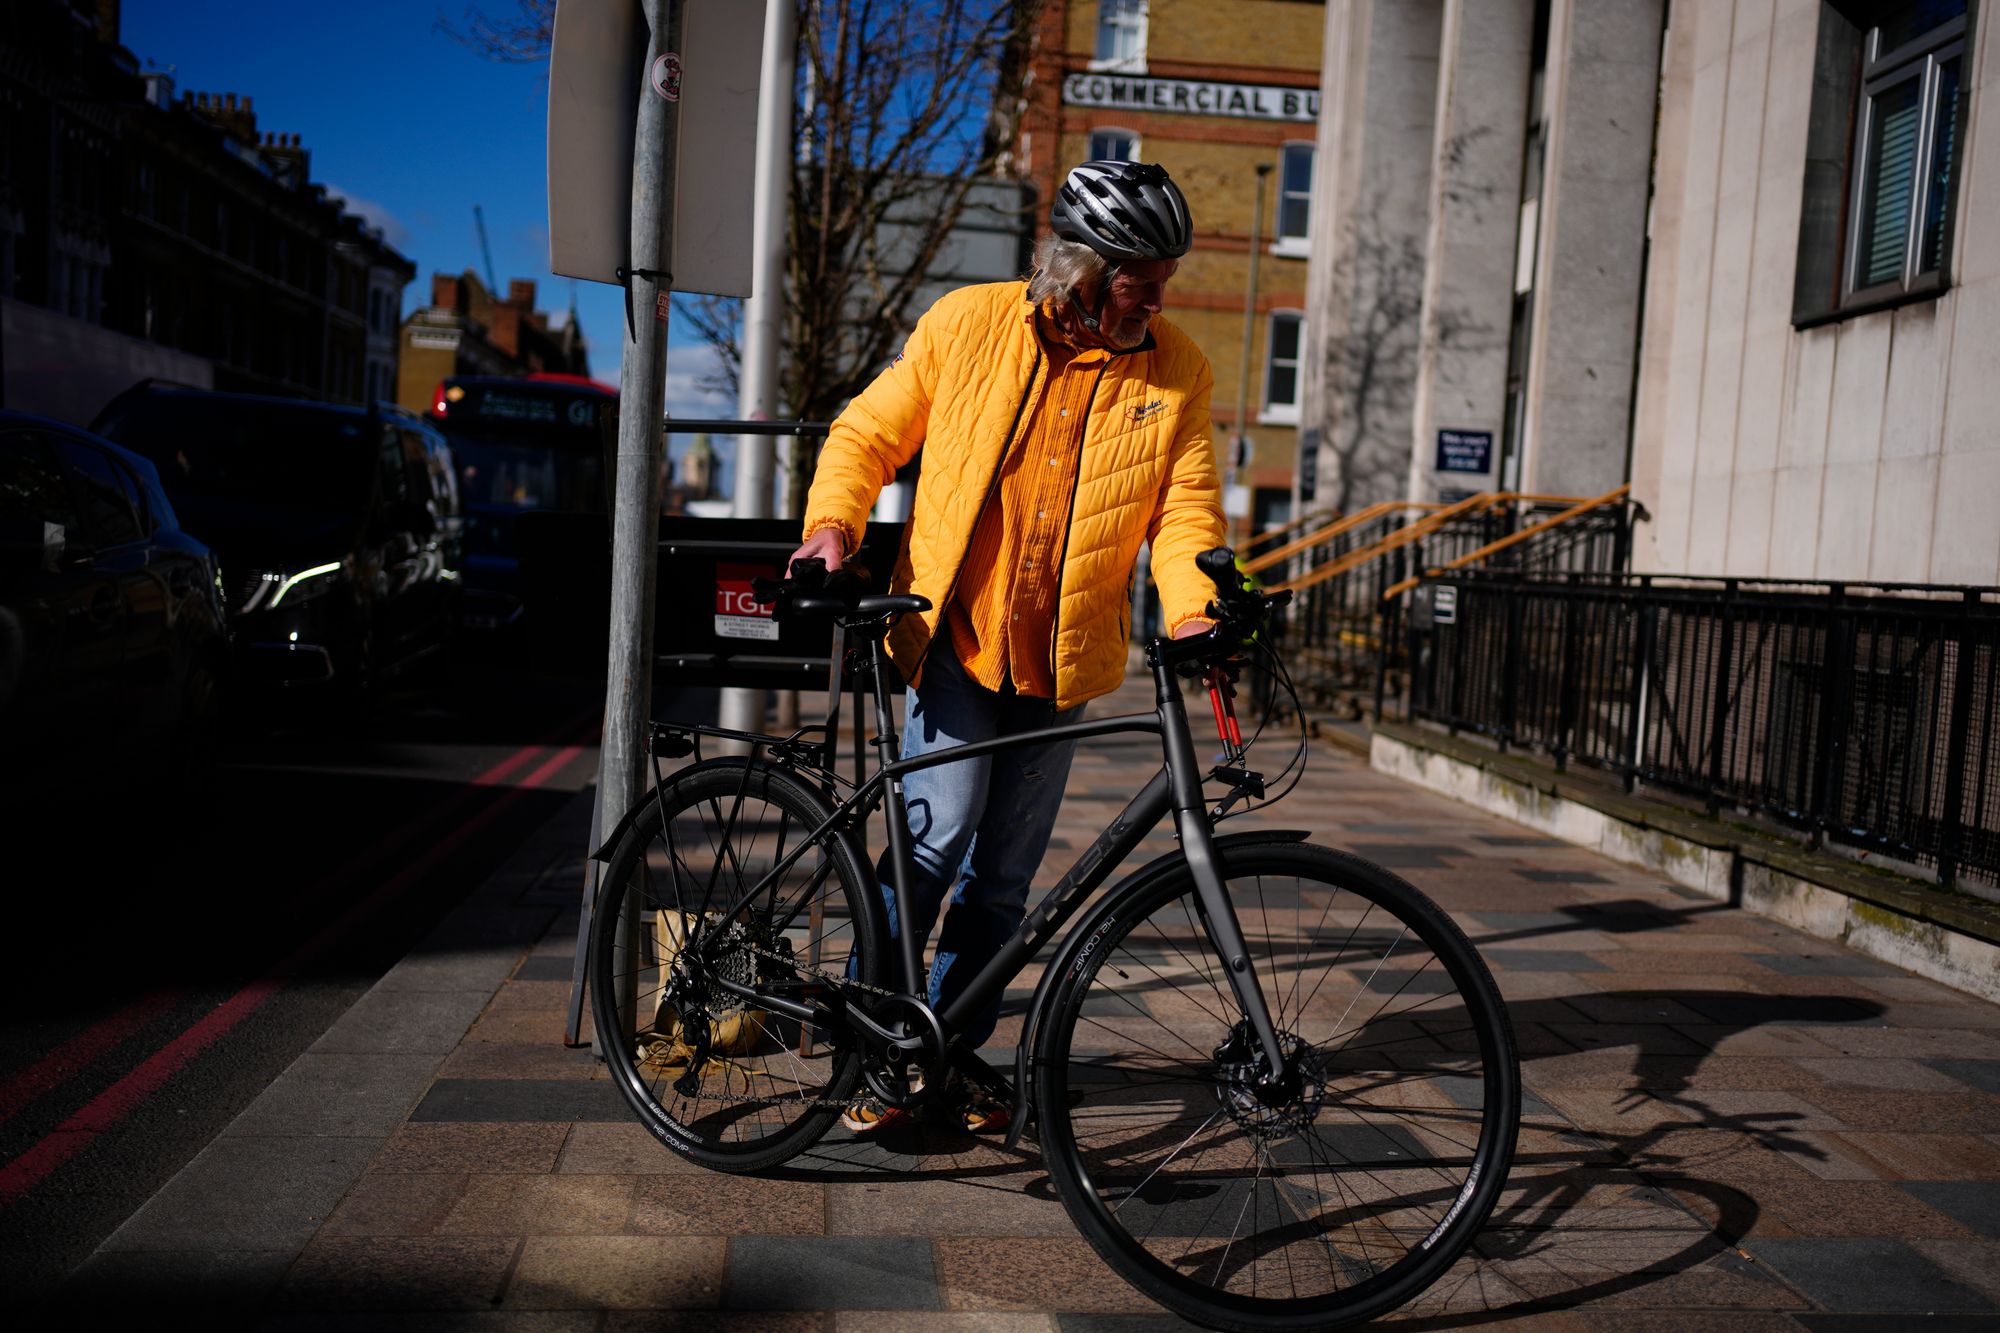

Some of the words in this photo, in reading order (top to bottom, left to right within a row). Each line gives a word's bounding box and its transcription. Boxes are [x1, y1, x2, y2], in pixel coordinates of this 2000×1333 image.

[1070, 78, 1269, 114] COMMERCIAL
[1101, 916, 1116, 934] H2
[1075, 935, 1101, 971] COMP
[652, 1107, 695, 1138] BONTRAGER
[653, 1124, 665, 1137] H2
[664, 1134, 689, 1151] COMP
[1428, 1178, 1477, 1243] BONTRAGER
